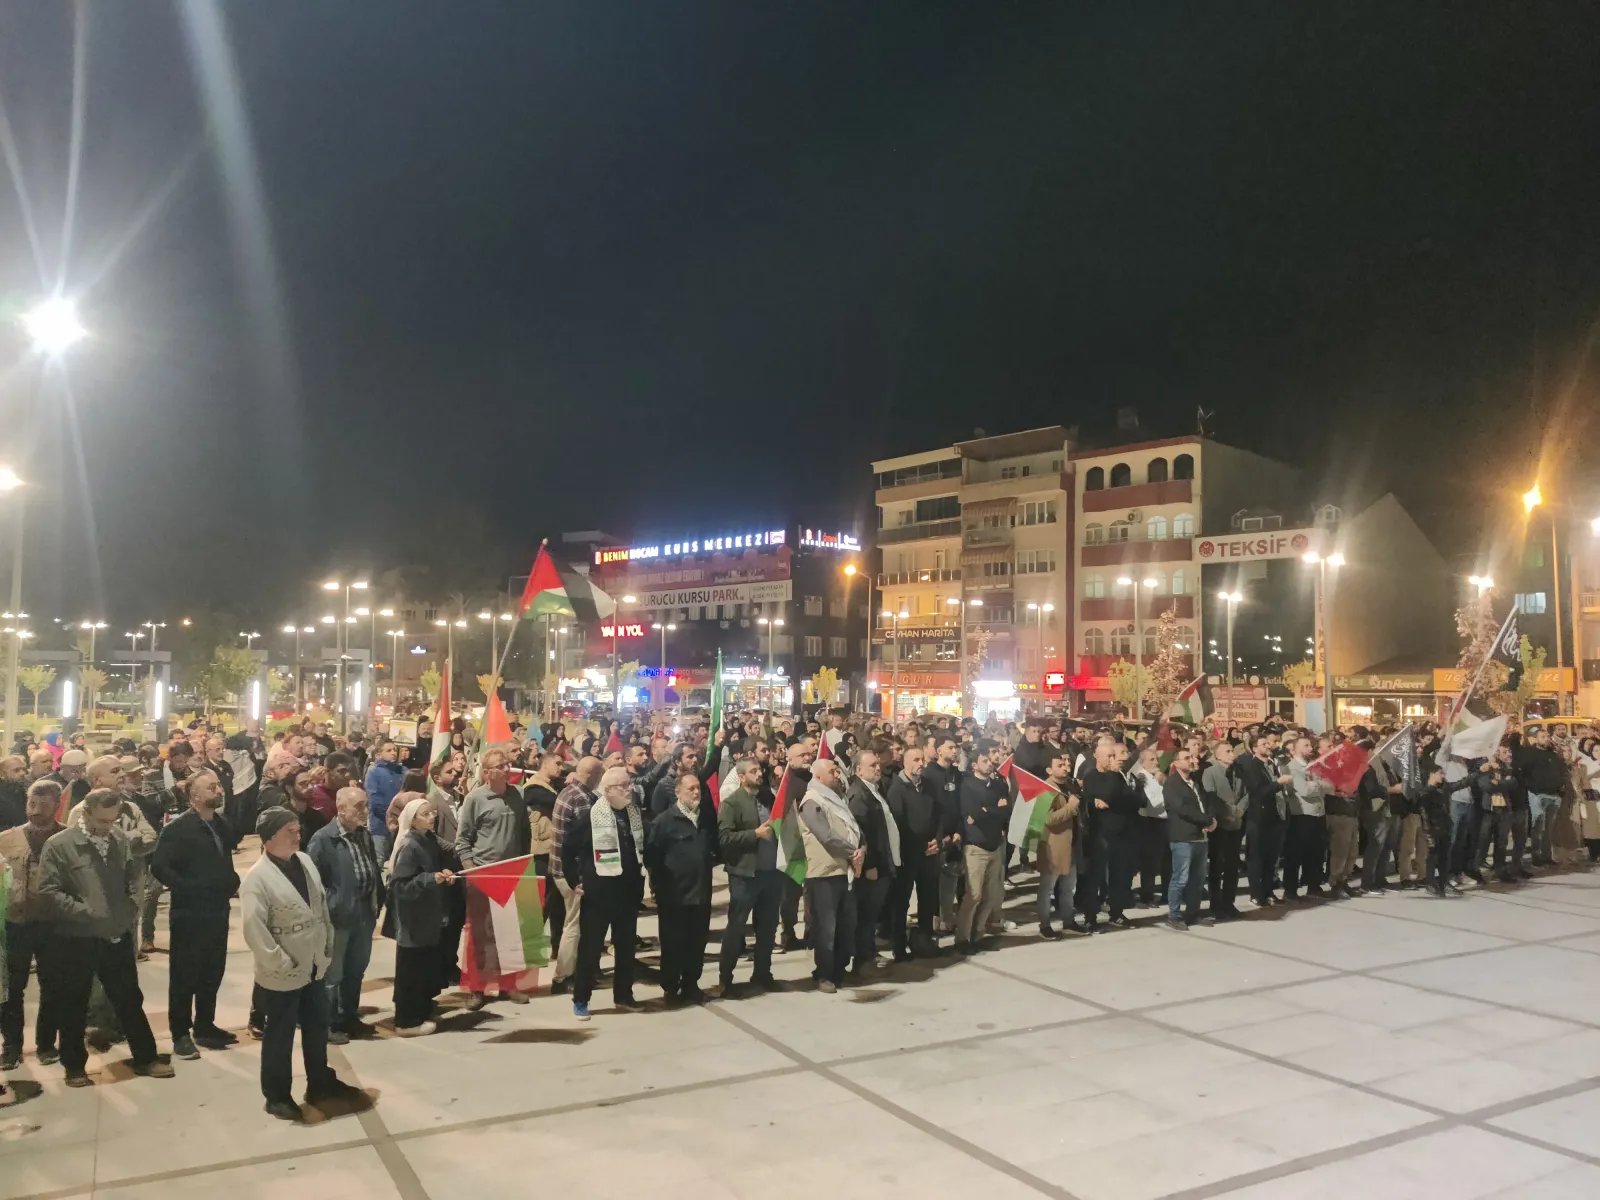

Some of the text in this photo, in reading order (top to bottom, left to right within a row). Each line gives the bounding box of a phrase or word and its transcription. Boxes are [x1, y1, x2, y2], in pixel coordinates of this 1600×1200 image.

[1216, 534, 1288, 558] TEKSİF
[677, 590, 710, 604] KURSU
[625, 624, 644, 637] YOL
[921, 627, 955, 638] HARİTA
